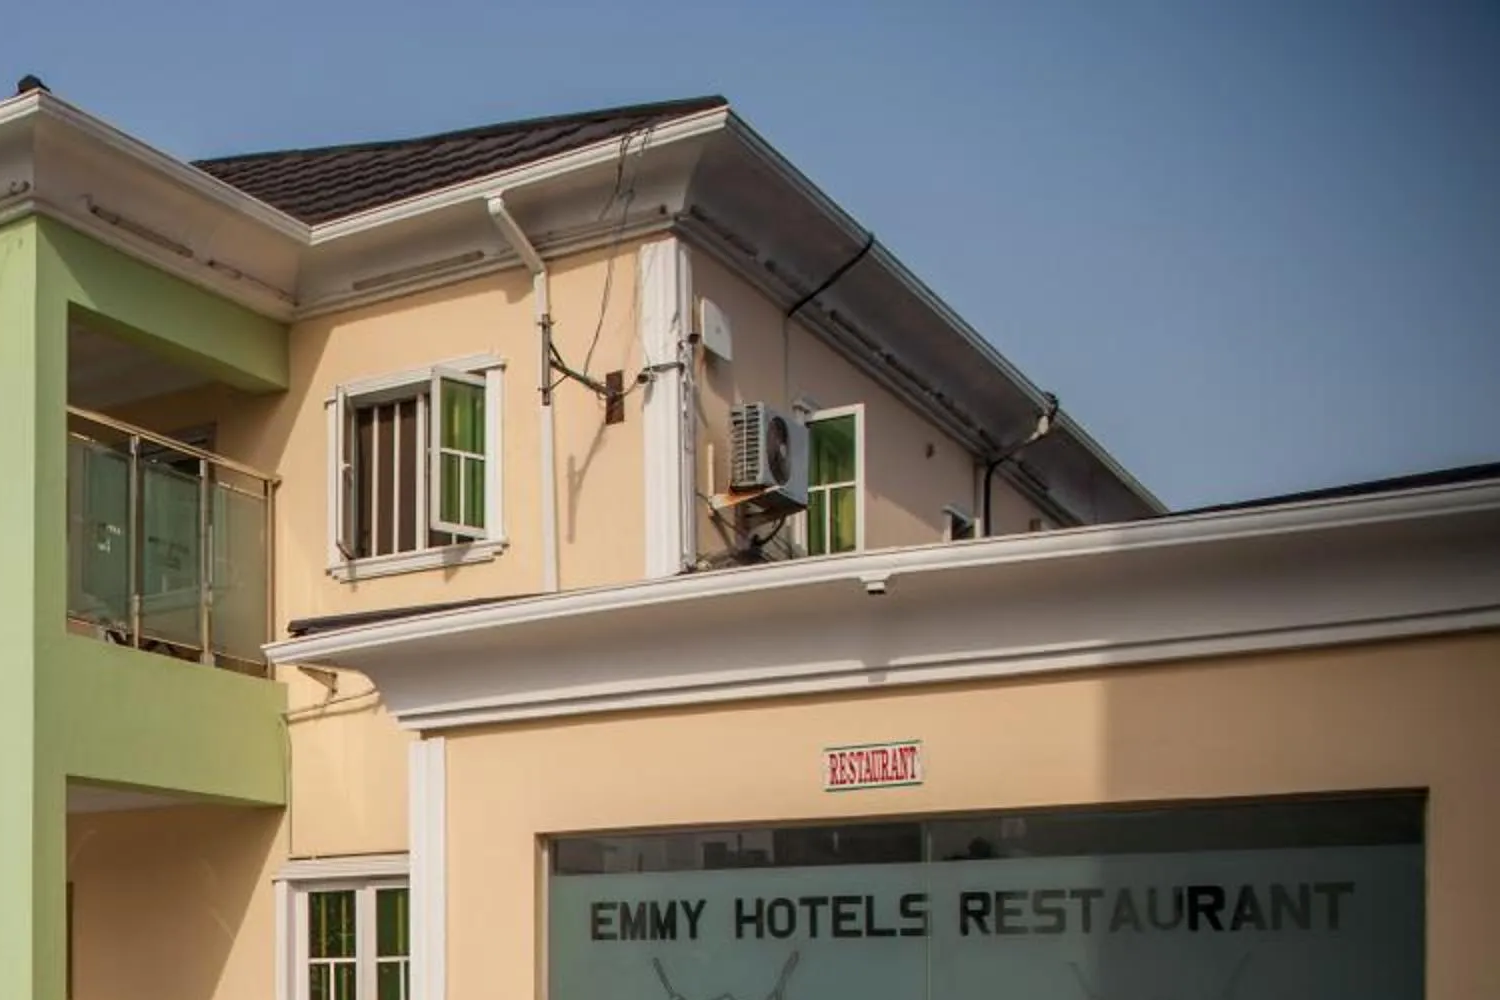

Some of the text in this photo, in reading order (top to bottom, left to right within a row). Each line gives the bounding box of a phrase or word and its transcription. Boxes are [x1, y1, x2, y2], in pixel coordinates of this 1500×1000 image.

[829, 746, 917, 785] RESTAURANT
[591, 882, 1355, 942] EMMY HOTELS RESTAURANT
